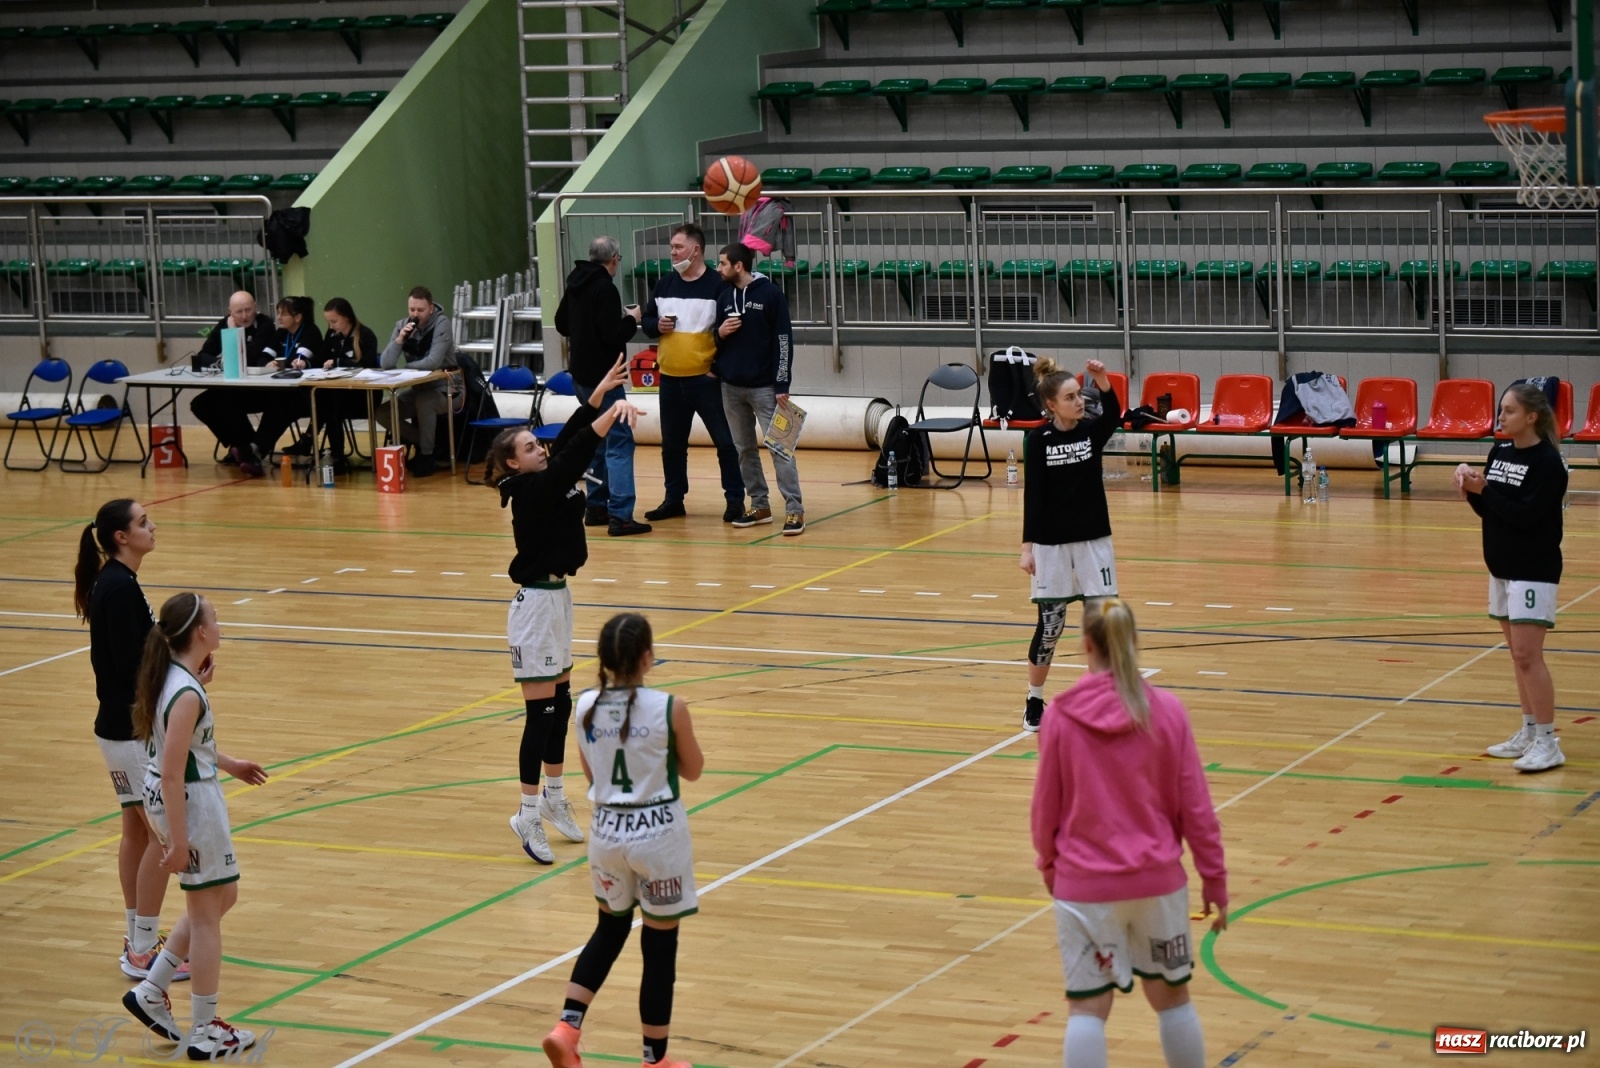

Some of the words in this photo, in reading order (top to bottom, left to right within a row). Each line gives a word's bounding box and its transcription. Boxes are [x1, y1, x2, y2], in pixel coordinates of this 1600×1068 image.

[381, 454, 394, 483] 5
[1100, 566, 1112, 586] 11
[1525, 588, 1536, 609] 9
[611, 748, 634, 794] 4
